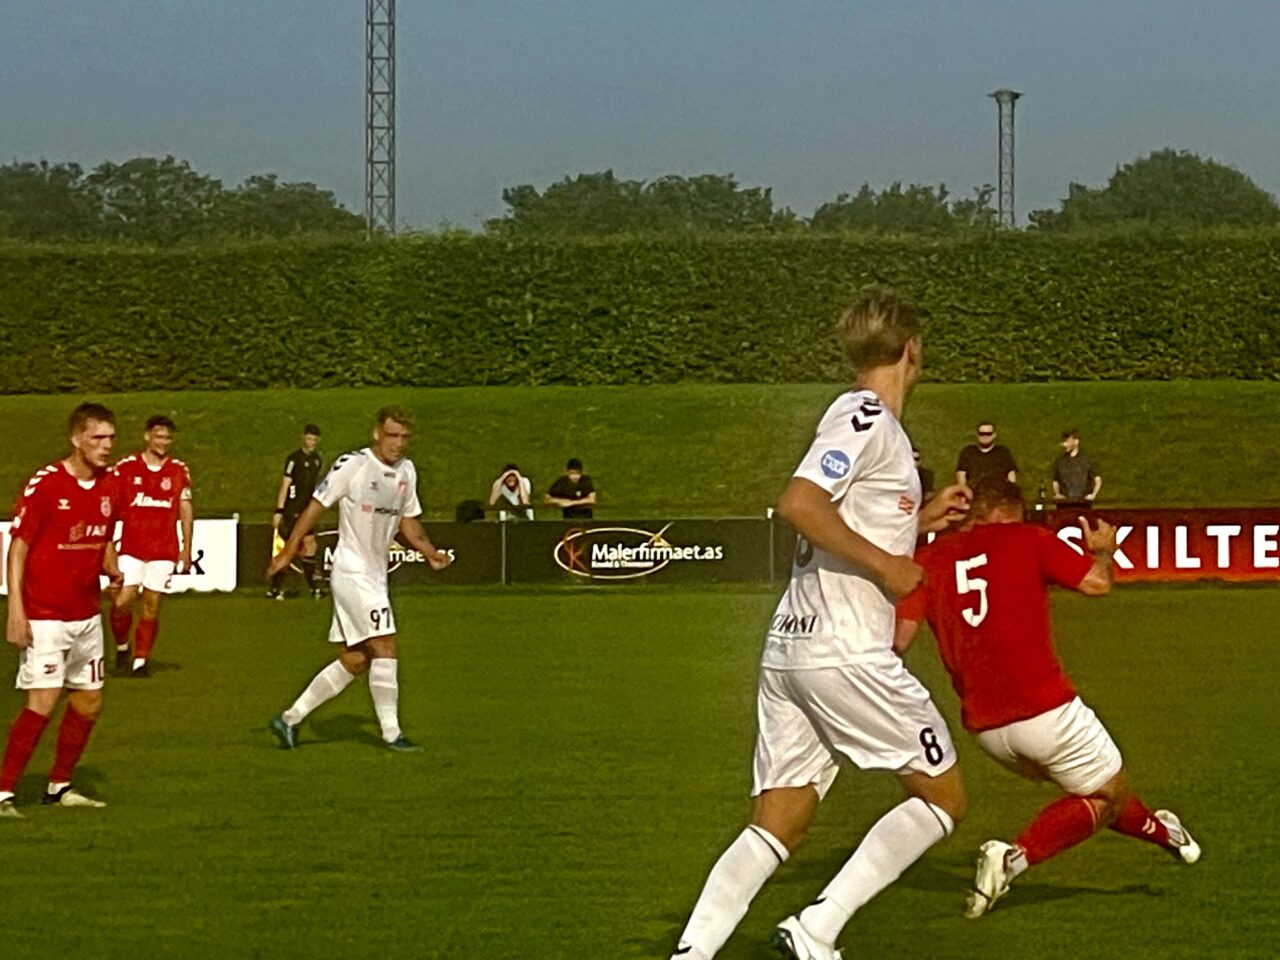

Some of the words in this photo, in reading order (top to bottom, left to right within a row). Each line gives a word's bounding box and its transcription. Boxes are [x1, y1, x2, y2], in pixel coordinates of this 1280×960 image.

[591, 543, 723, 561] Malerfirmaet.as
[955, 553, 988, 627] 5
[370, 607, 391, 630] 97
[919, 727, 944, 766] 8
